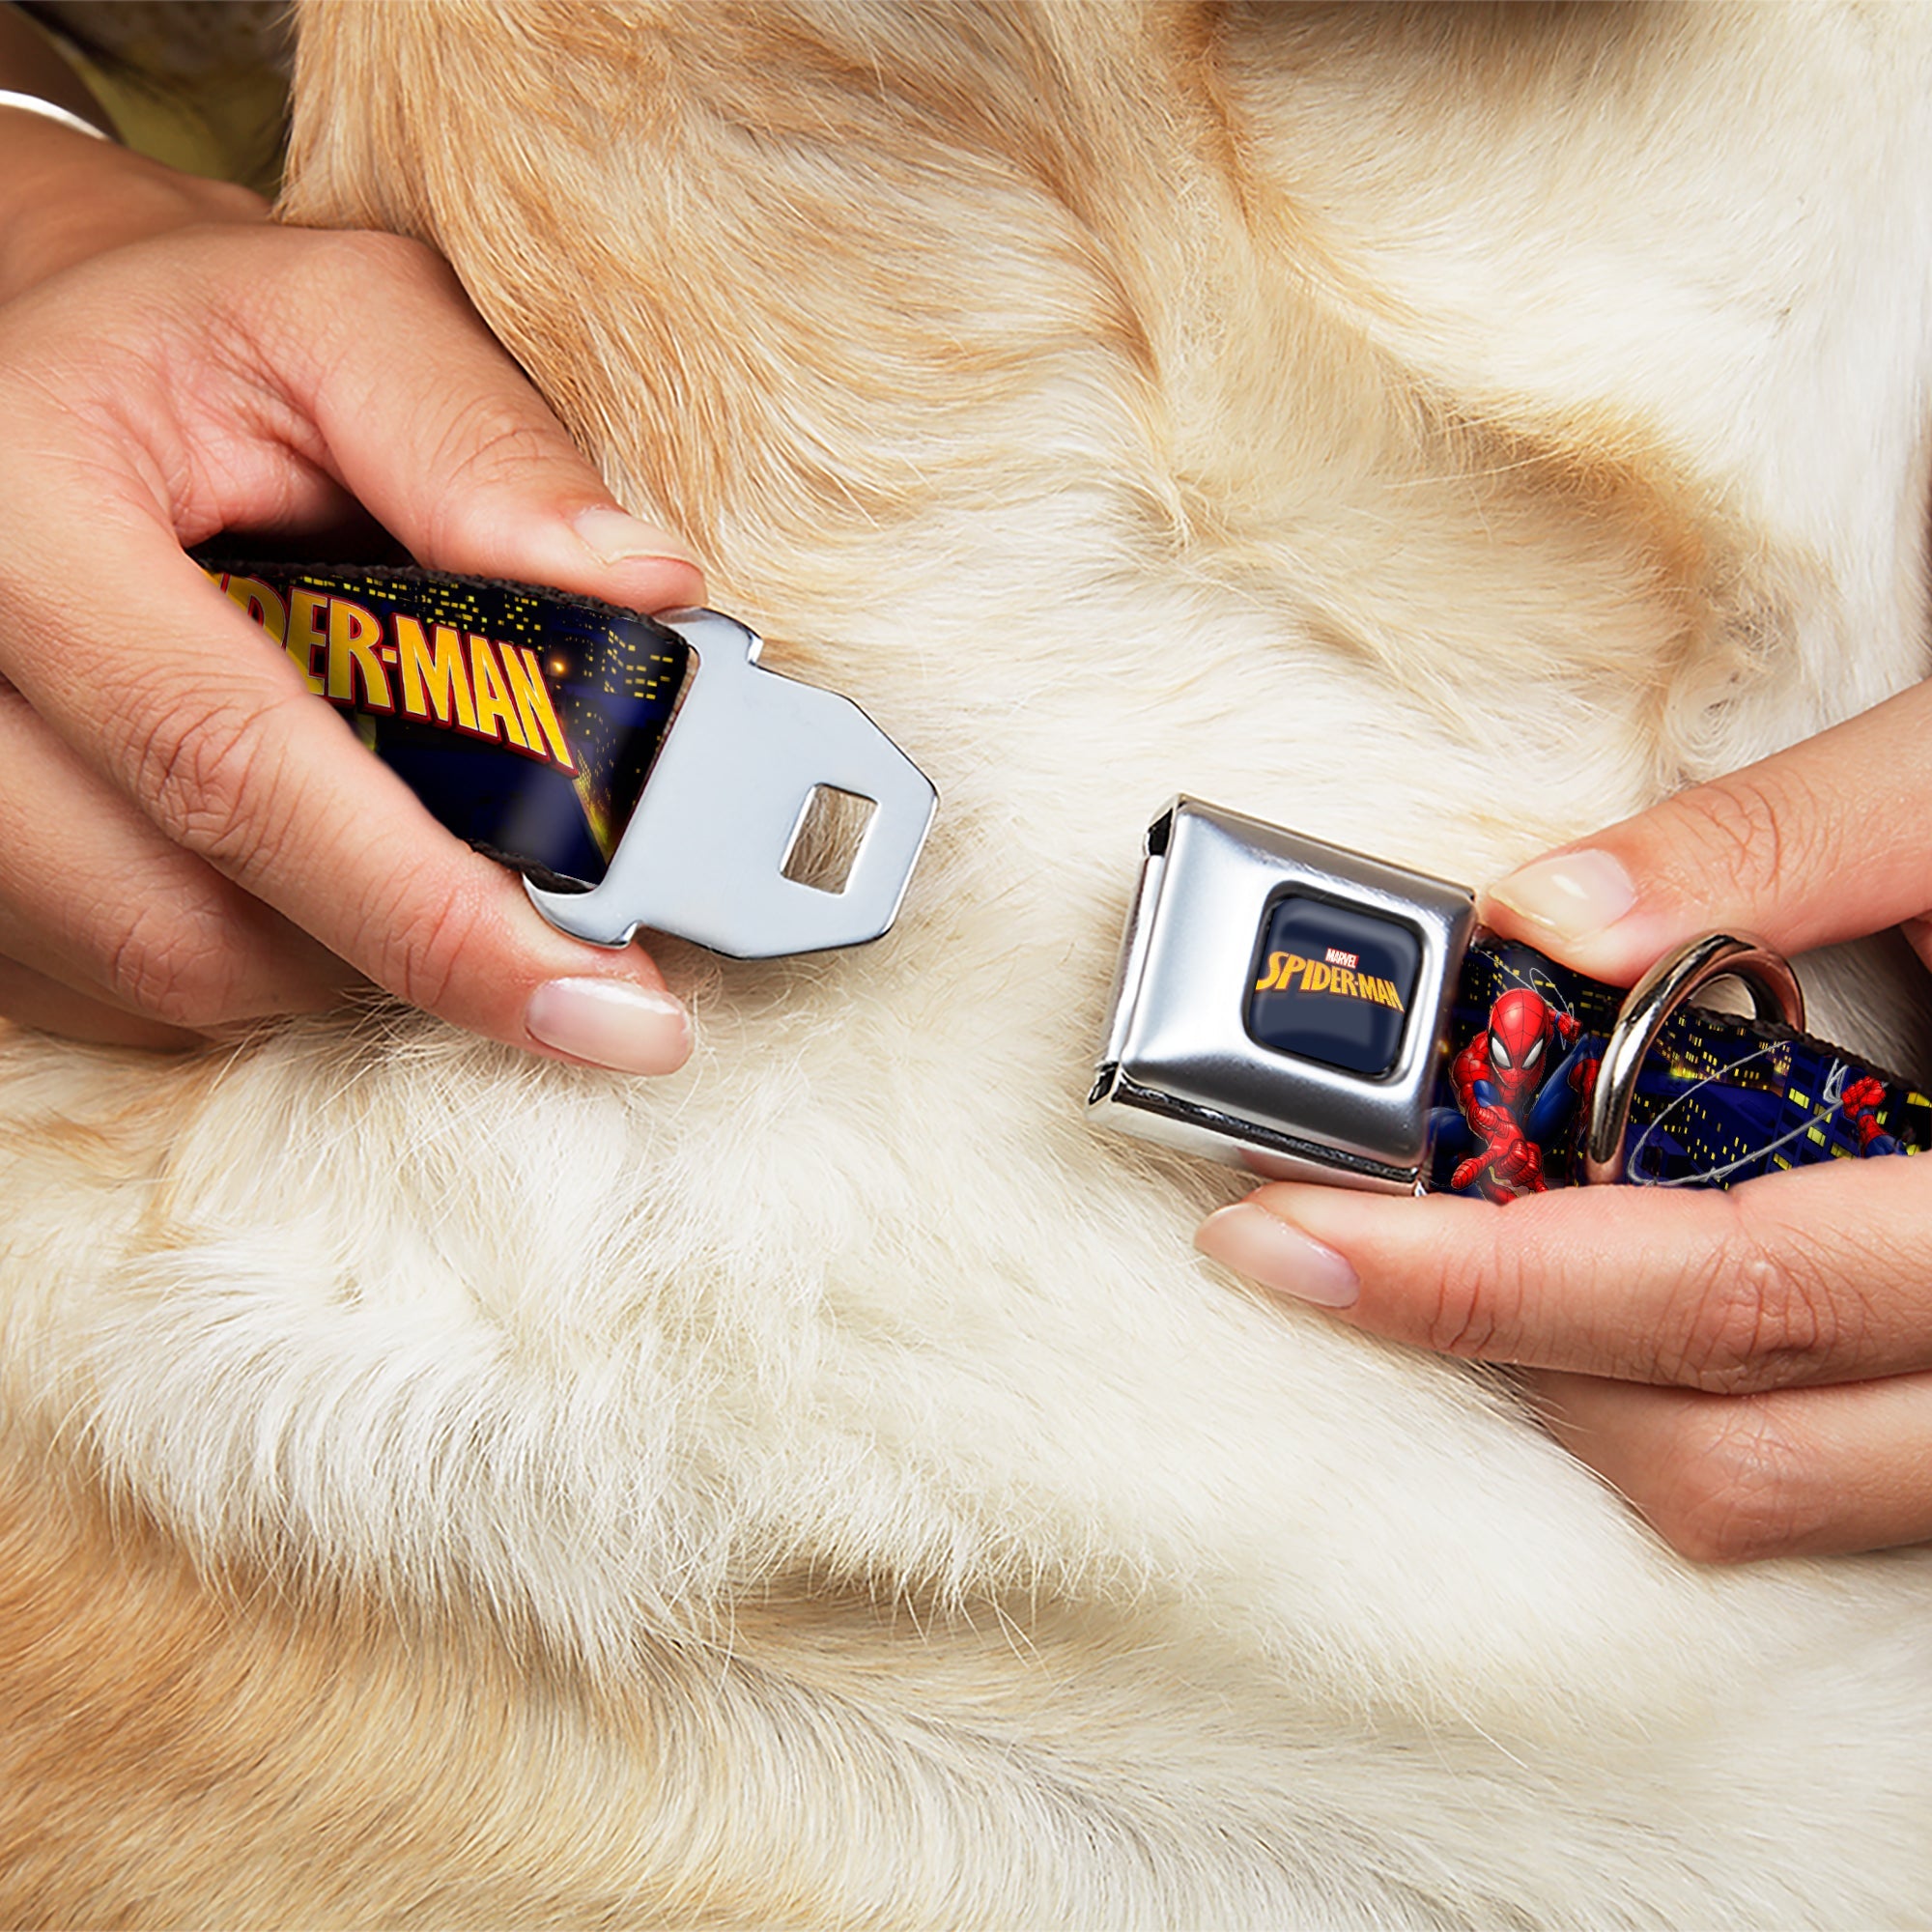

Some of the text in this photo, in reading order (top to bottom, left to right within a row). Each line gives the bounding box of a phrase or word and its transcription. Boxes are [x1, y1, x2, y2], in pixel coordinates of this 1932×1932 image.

[203, 573, 579, 774] DER-MAN
[1255, 951, 1405, 1013] SPIDER-MAN
[1325, 947, 1358, 969] MARVEL
